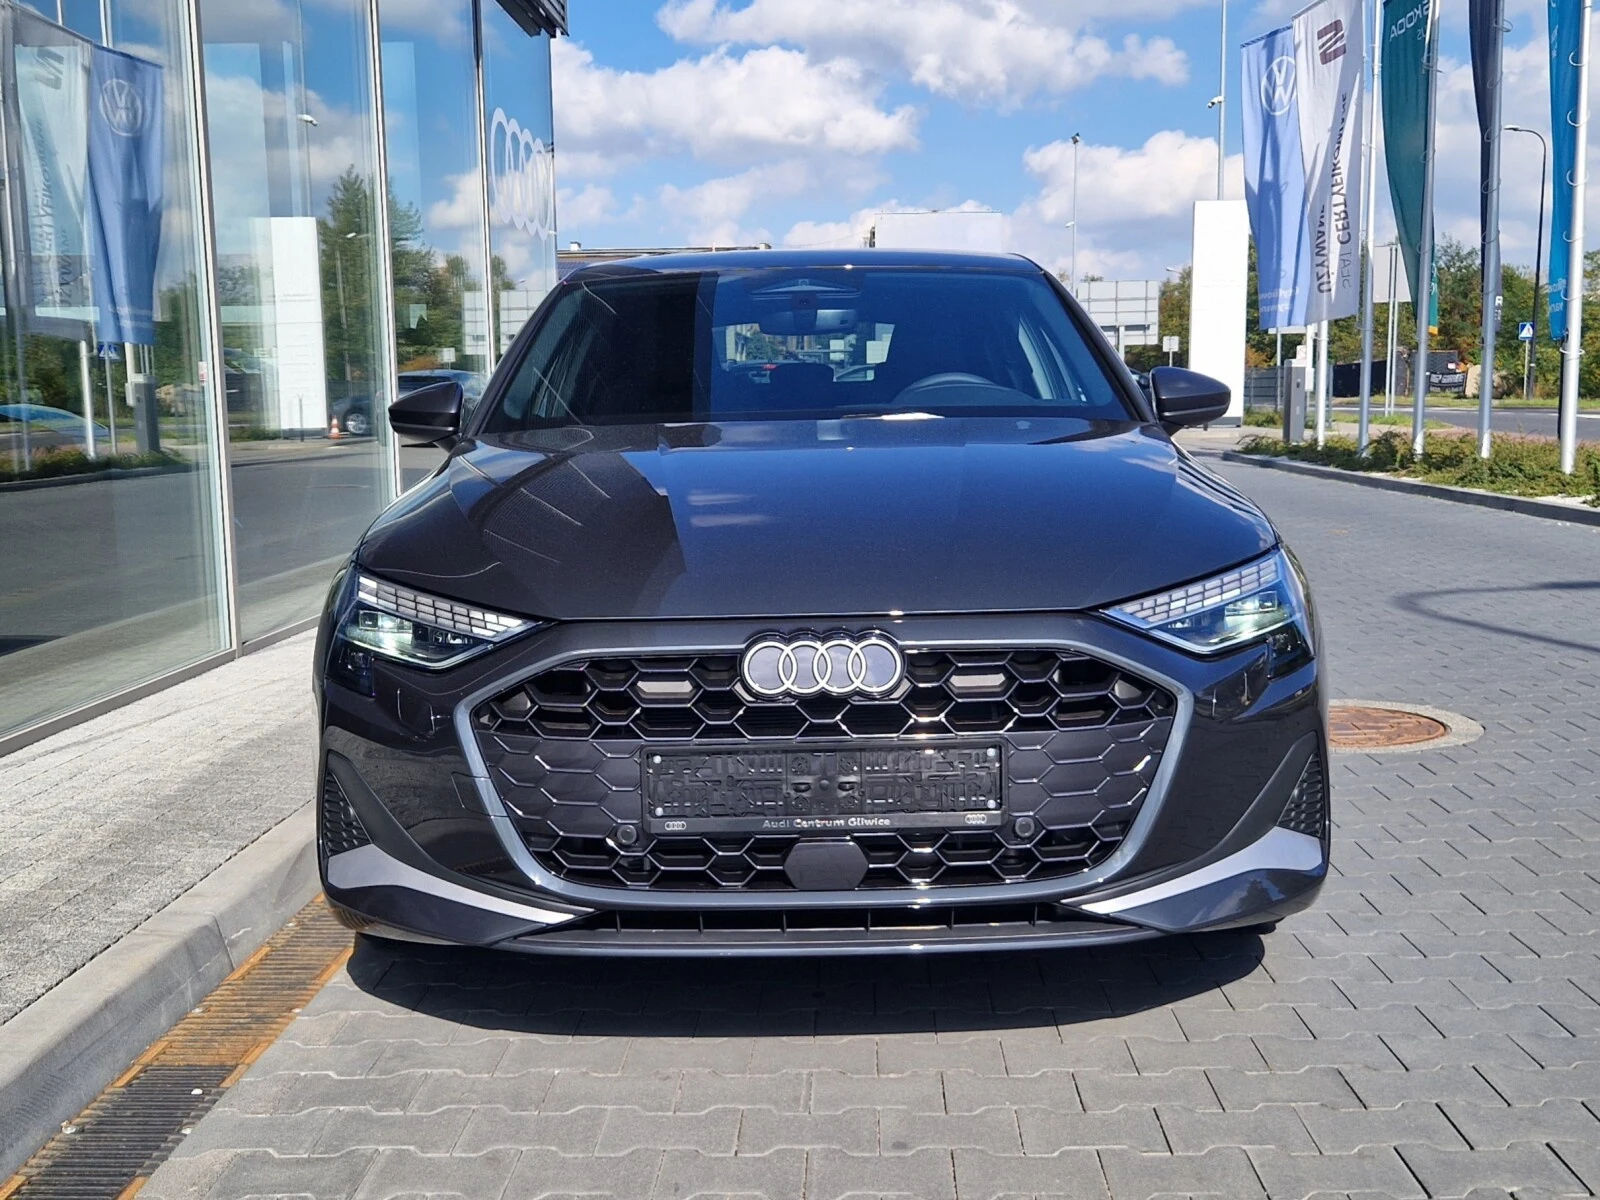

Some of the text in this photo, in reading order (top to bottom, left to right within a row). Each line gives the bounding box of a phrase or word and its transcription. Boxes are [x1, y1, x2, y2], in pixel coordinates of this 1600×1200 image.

[762, 817, 891, 829] Audi Centrum Gliwice
